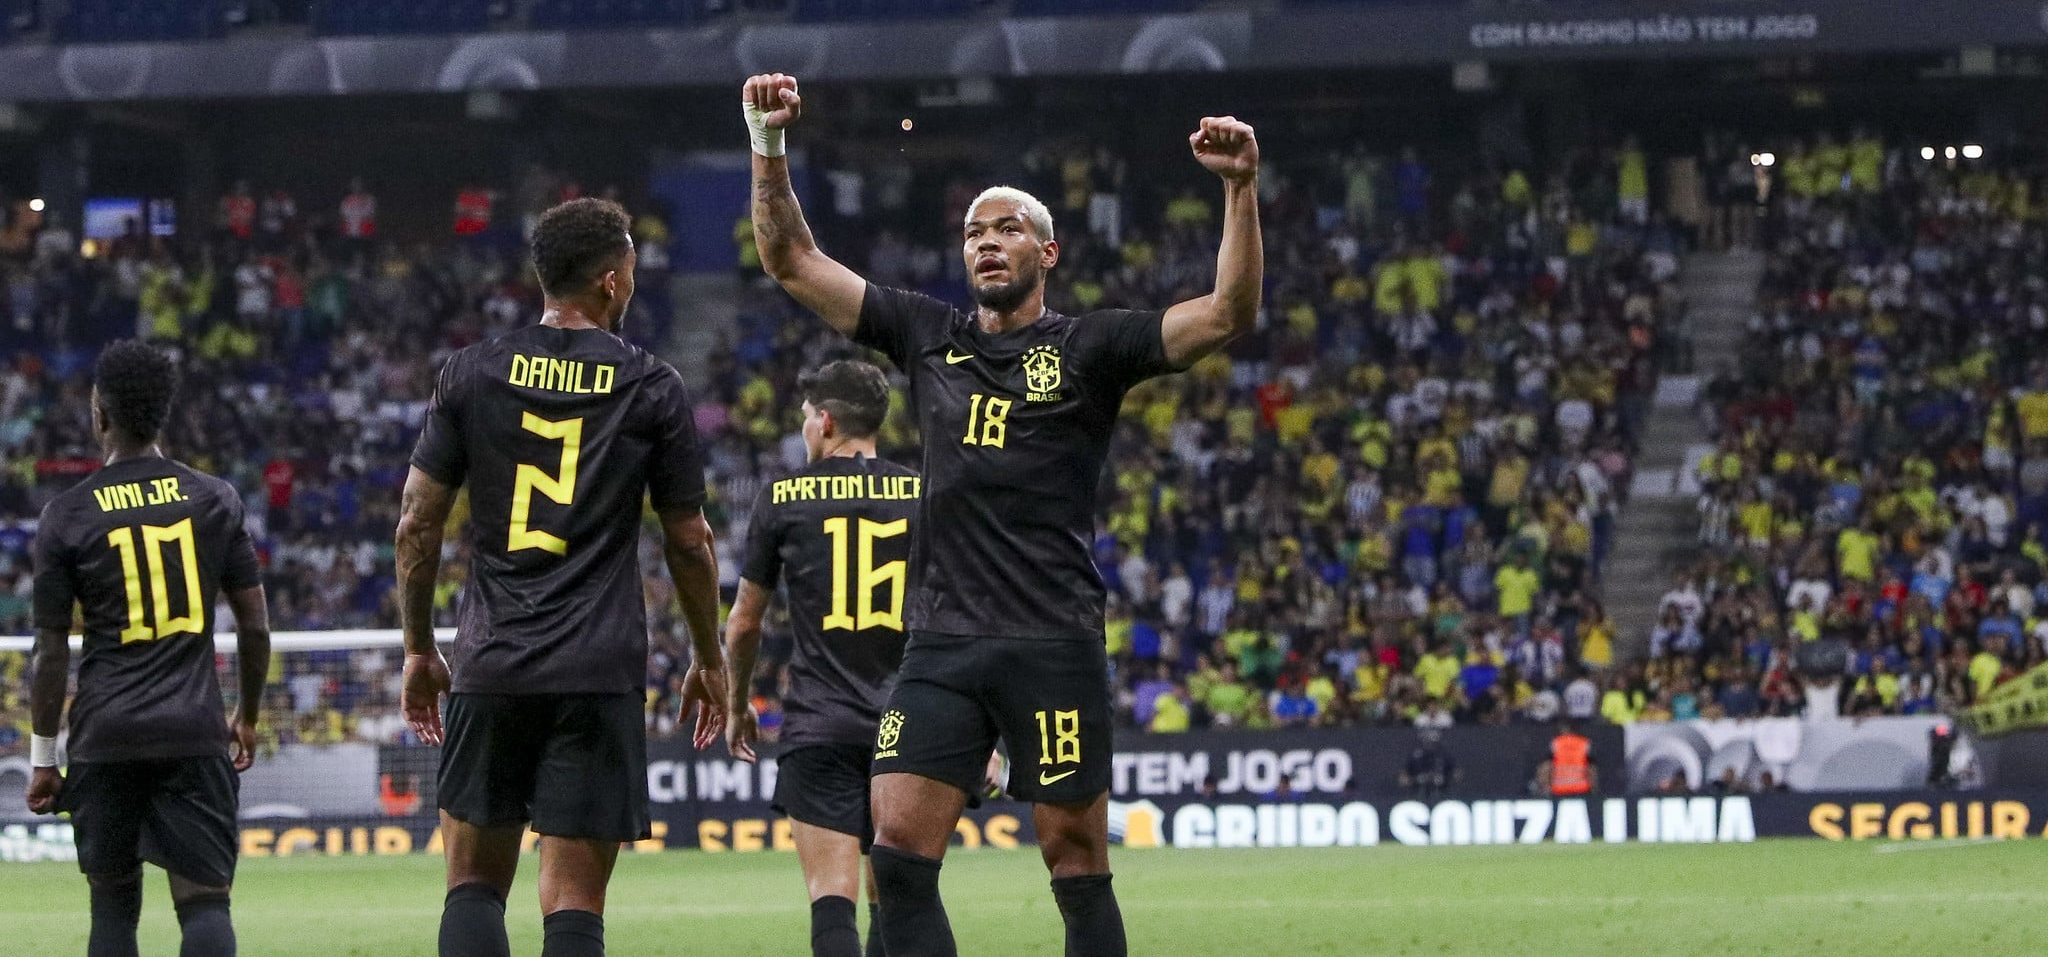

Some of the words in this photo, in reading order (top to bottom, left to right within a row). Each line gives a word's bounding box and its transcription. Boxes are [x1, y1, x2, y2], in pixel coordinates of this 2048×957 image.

[509, 353, 615, 394] DANILO
[1026, 392, 1064, 402] BRASIL
[963, 393, 1012, 449] 18
[93, 483, 145, 512] VINI
[147, 477, 189, 505] JR.
[508, 411, 584, 556] 2
[772, 475, 863, 505] AYRTON
[107, 517, 204, 645] 10
[823, 517, 908, 632] 16
[875, 749, 899, 761] BRASIL
[1035, 709, 1081, 765] 18
[1111, 751, 1209, 796] TEM
[1216, 748, 1353, 794] JOGO
[1808, 800, 2048, 842] SEGUR
